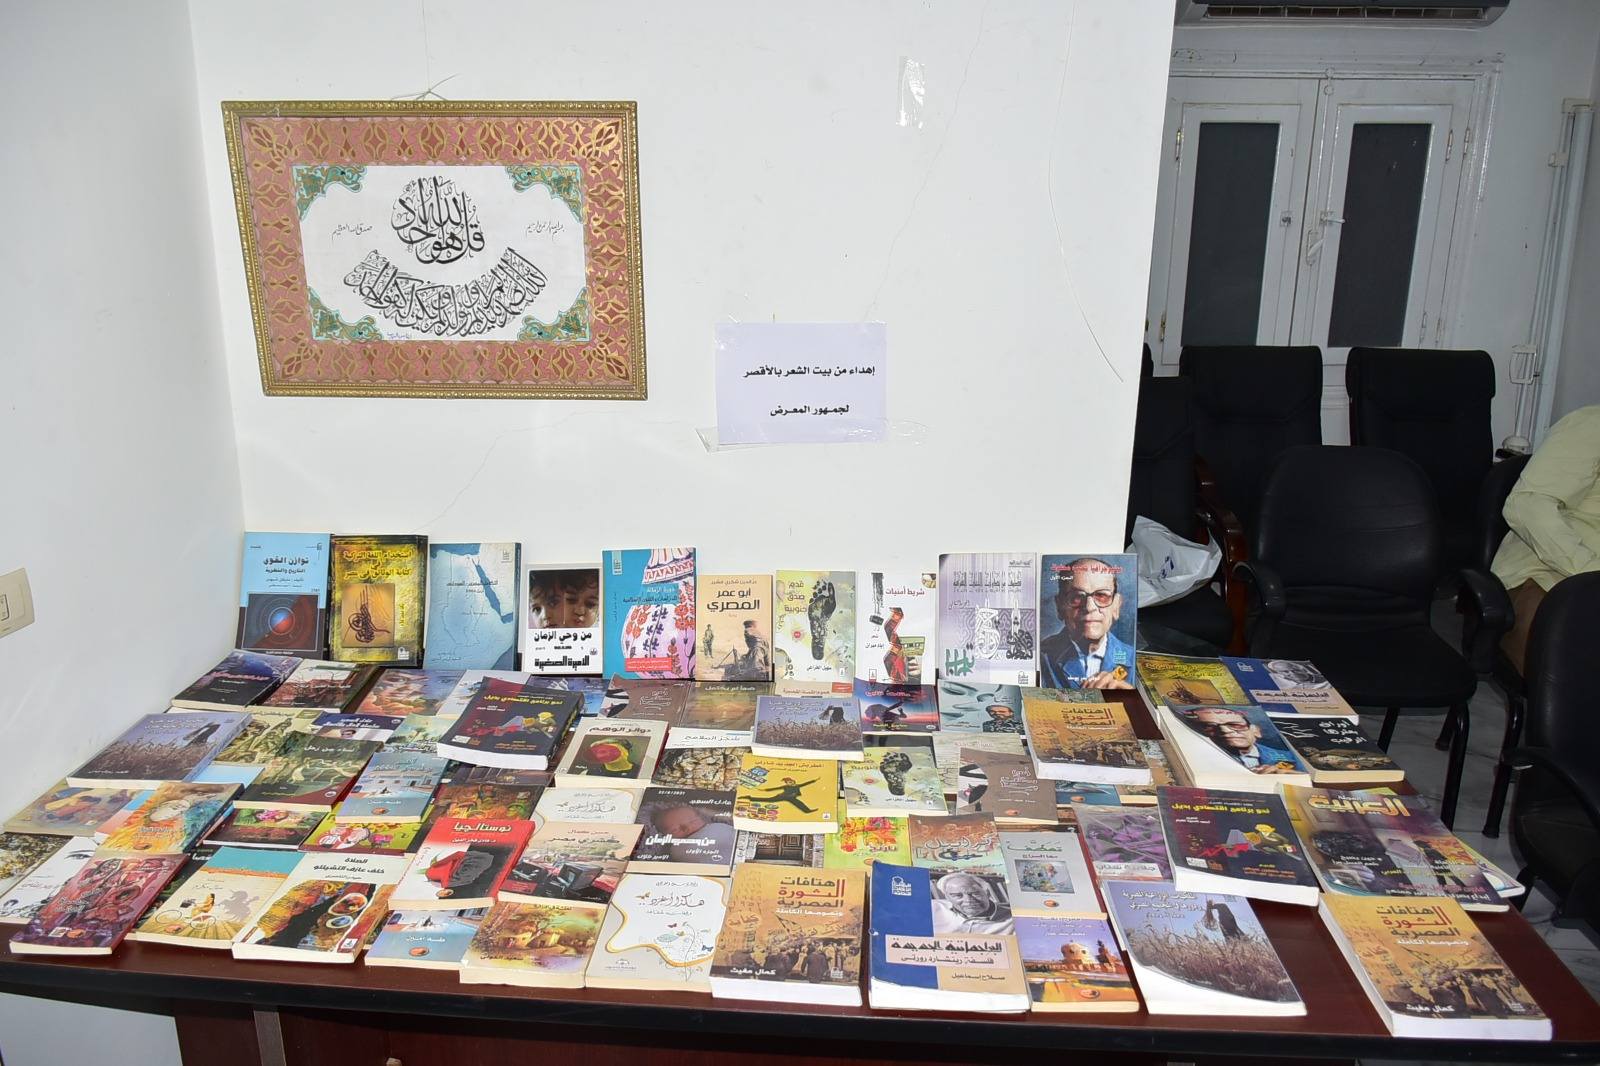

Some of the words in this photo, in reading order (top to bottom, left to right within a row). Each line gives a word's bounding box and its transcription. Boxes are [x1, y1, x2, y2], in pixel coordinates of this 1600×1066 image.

[743, 365, 782, 378] بالأقصر
[785, 366, 810, 377] الشعر
[812, 366, 832, 376] بيت
[833, 366, 847, 376] من
[849, 365, 875, 376] إهداء
[770, 405, 810, 416] المعرض
[812, 404, 850, 416] لجمهور
[343, 550, 367, 561] التركية
[368, 550, 383, 559] اللغة
[383, 550, 412, 559] استخدام
[288, 556, 309, 566] توازن
[343, 571, 359, 580] مصر
[372, 569, 396, 579] الوثائق
[396, 568, 412, 576] كتابة
[788, 580, 805, 589] قدم
[717, 590, 736, 598] عمر
[885, 586, 906, 597] أمنيات
[907, 588, 925, 597] شريط
[706, 599, 760, 612] المصري
[534, 630, 557, 642] الزمان
[558, 632, 578, 643] وحي
[580, 630, 592, 642] من
[534, 656, 568, 671] الصغيرة
[1193, 804, 1228, 812] اقتصادي
[1230, 806, 1255, 814] برنامج
[1308, 794, 1411, 817] العربية
[644, 833, 673, 846] الزمان
[701, 837, 716, 846] من
[779, 876, 836, 887] هتافات
[777, 878, 846, 899] الثورة
[777, 898, 845, 909] المصرية
[1375, 905, 1436, 915] هتافات
[1380, 905, 1453, 929] الثورة
[1390, 927, 1461, 939] المصرية
[965, 956, 995, 965] فلسفة
[729, 967, 754, 975] مغيث
[754, 968, 777, 976] كمال
[981, 974, 1006, 982] صلاح
[1405, 1003, 1431, 1012] مغيث
[1432, 1004, 1455, 1012] كمال
